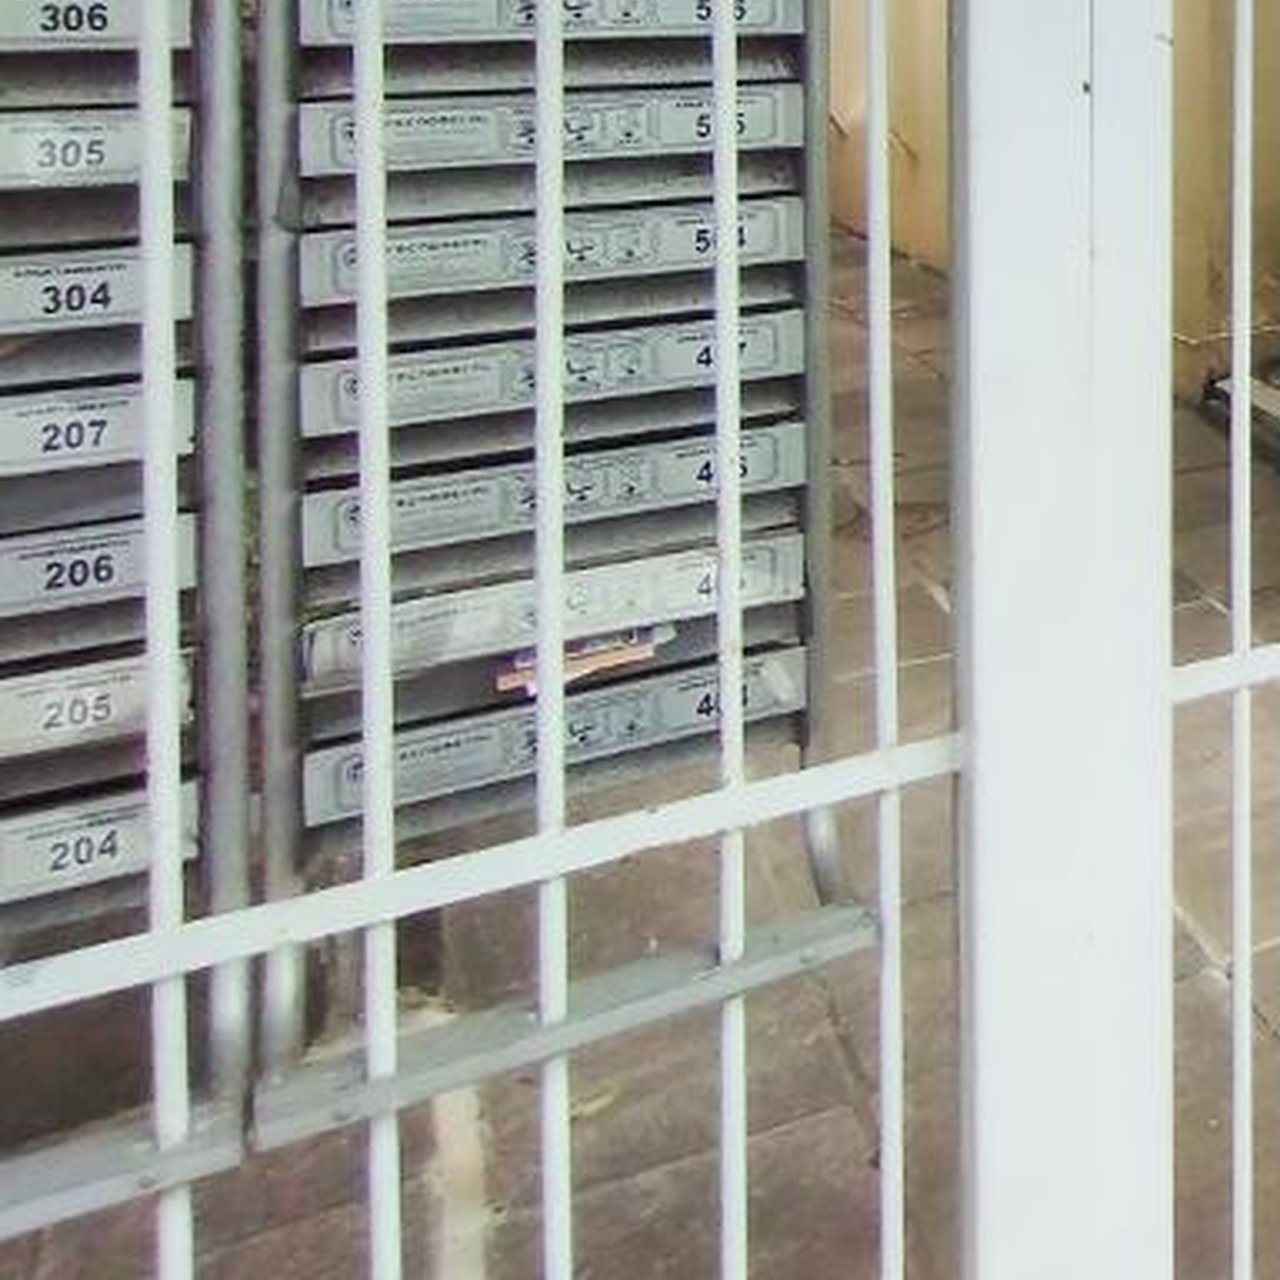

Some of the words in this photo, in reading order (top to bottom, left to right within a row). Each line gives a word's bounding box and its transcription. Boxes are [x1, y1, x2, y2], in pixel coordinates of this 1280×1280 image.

[40, 2, 109, 32] 306
[38, 139, 105, 168] 305
[41, 280, 111, 314] 304
[42, 419, 108, 453] 207
[44, 554, 114, 590] 206
[42, 692, 112, 731] 205
[50, 828, 118, 872] 204
